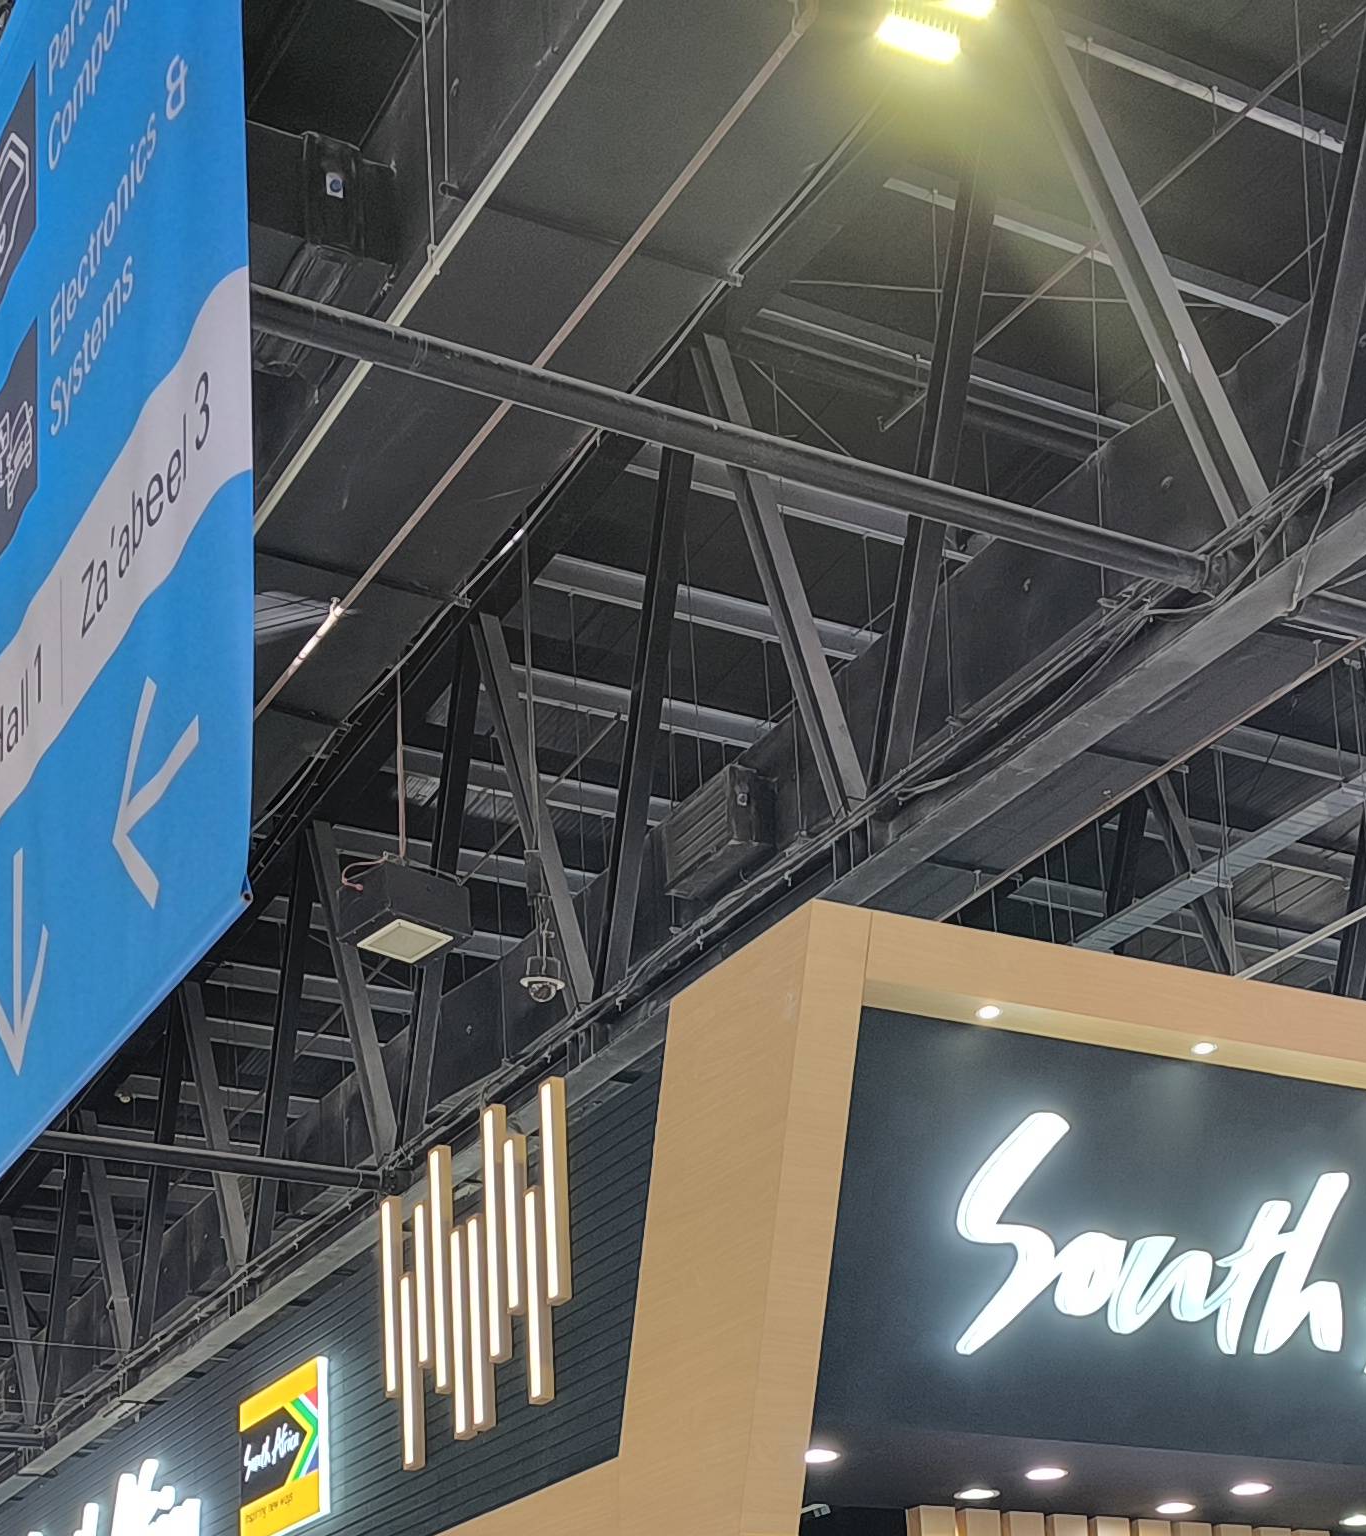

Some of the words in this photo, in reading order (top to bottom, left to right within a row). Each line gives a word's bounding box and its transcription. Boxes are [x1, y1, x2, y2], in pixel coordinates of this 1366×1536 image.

[49, 111, 157, 357] Electronics
[165, 54, 188, 121] &
[49, 255, 134, 437] Systems
[81, 413, 187, 638] Za'abeel
[195, 371, 211, 451] 3
[33, 643, 44, 704] 1
[956, 1111, 1351, 1357] South
[243, 1434, 271, 1482] South
[271, 1423, 300, 1465] Africa
